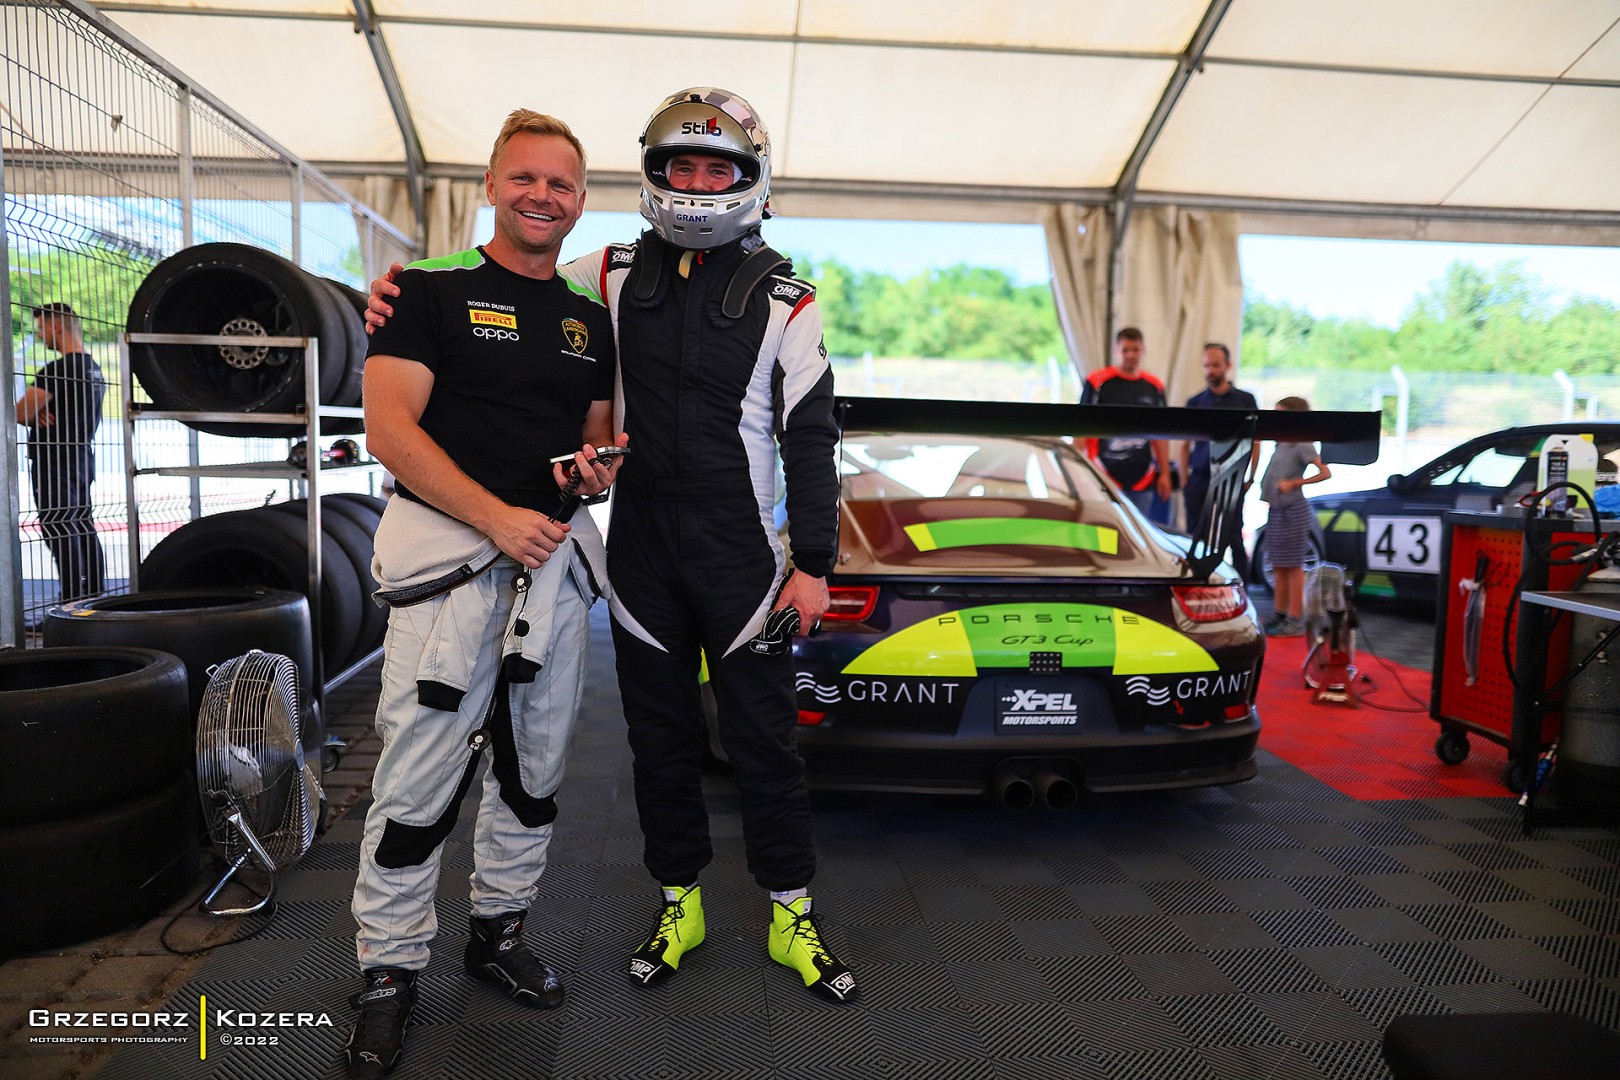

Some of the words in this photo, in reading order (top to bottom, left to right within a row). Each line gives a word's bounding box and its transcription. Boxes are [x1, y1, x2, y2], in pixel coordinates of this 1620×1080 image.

[681, 117, 722, 137] Stilo
[676, 213, 708, 223] GRANT
[774, 284, 800, 298] OMP
[467, 300, 490, 308] ROGER
[491, 303, 515, 312] DUBUIS
[474, 312, 512, 326] PIRELLI
[473, 327, 520, 341] oppo
[1374, 523, 1429, 565] 43
[938, 614, 1140, 626] PORSCHE
[1001, 635, 1047, 645] GT3
[1054, 635, 1093, 647] Cup
[1176, 669, 1252, 699] GRANT
[847, 680, 960, 704] GRANT
[1010, 689, 1078, 711] XPEL
[1002, 715, 1078, 725] MOTORSPORTS
[834, 974, 855, 990] OM
